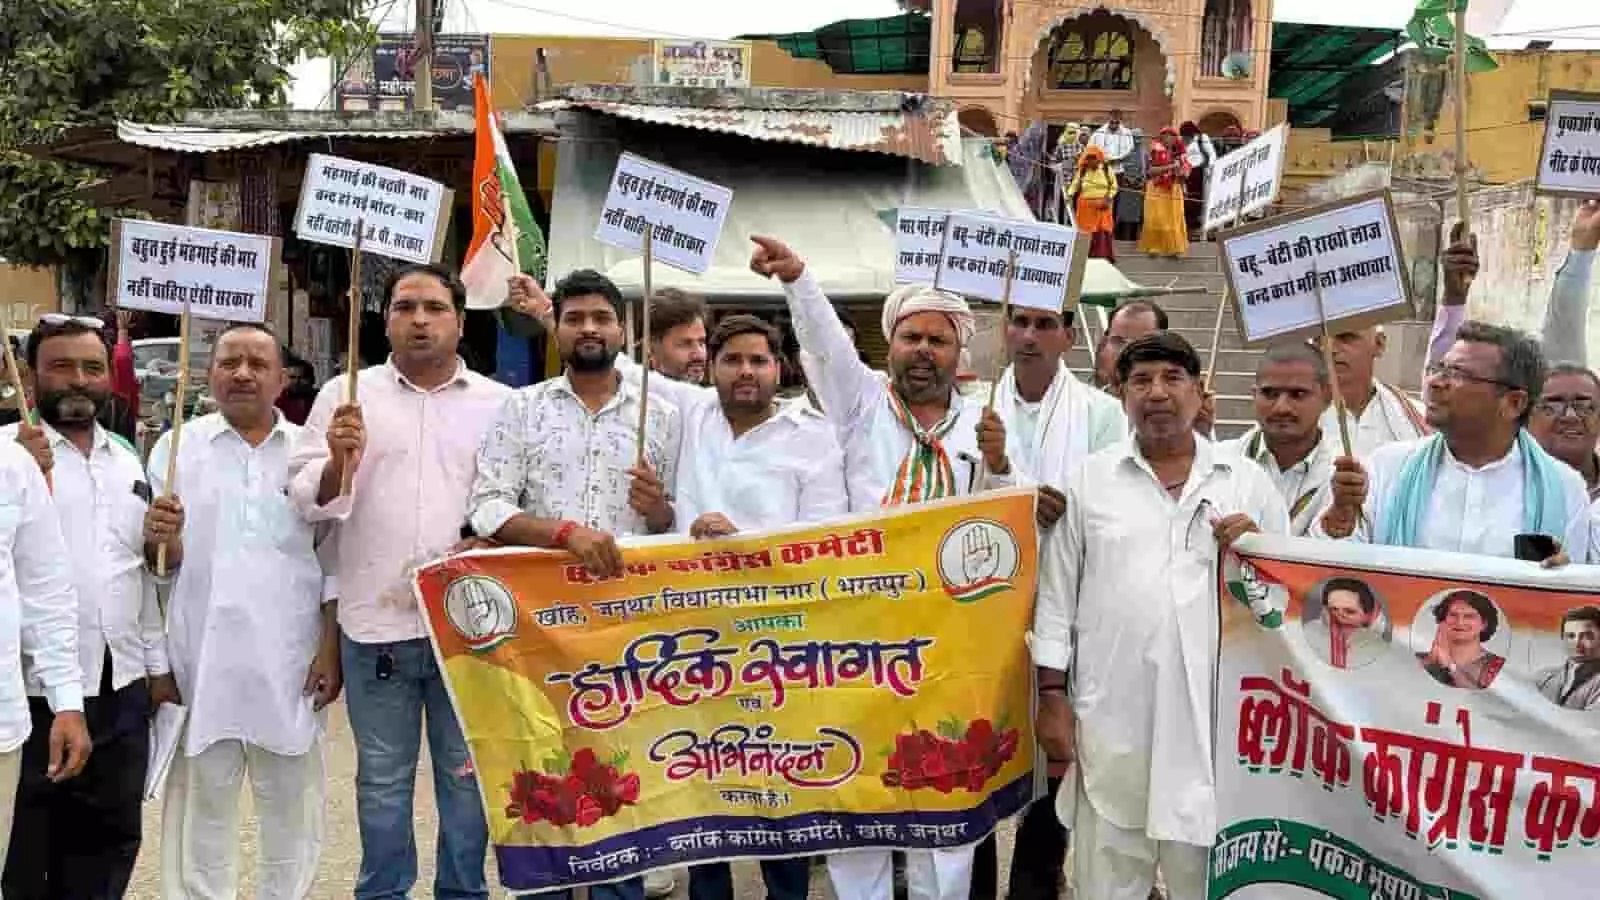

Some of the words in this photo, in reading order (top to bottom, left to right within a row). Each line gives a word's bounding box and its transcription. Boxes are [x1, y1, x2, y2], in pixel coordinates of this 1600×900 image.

[361, 170, 377, 188] की
[409, 184, 430, 201] मार
[617, 171, 641, 195] बहुत
[638, 176, 657, 200] हुई
[686, 191, 701, 214] की
[700, 200, 719, 218] मार
[351, 194, 368, 212] गई
[393, 231, 425, 253] सरकार
[623, 215, 653, 234] चाहि
[673, 231, 707, 255] सरकार
[996, 228, 1012, 249] की
[1040, 239, 1067, 258] लाज
[1292, 233, 1313, 258] की
[1349, 221, 1382, 245] लाज
[131, 236, 158, 264] बहुत
[159, 237, 178, 266] हुई
[219, 244, 237, 267] की
[237, 248, 259, 270] मार
[987, 259, 1019, 280] महिा
[127, 276, 152, 298] नहीं
[152, 280, 187, 302] चाहिए
[214, 288, 256, 309] सरकार
[776, 527, 885, 565] कमेटी
[662, 585, 769, 611] विधानसभा
[772, 581, 816, 601] नगर
[734, 613, 805, 633] आपका
[547, 628, 739, 730] हार्दिक
[741, 636, 934, 709] स्वागत
[649, 723, 863, 788] अभिनंदन
[1237, 667, 1355, 791] ब्लॉक
[1360, 700, 1525, 855] कांग्रेस
[719, 789, 763, 808] करता
[568, 847, 640, 875] निवेदक
[667, 826, 723, 853] ब्लॉक
[726, 824, 785, 850] कांग्रेस
[1308, 831, 1365, 885] पंकज
